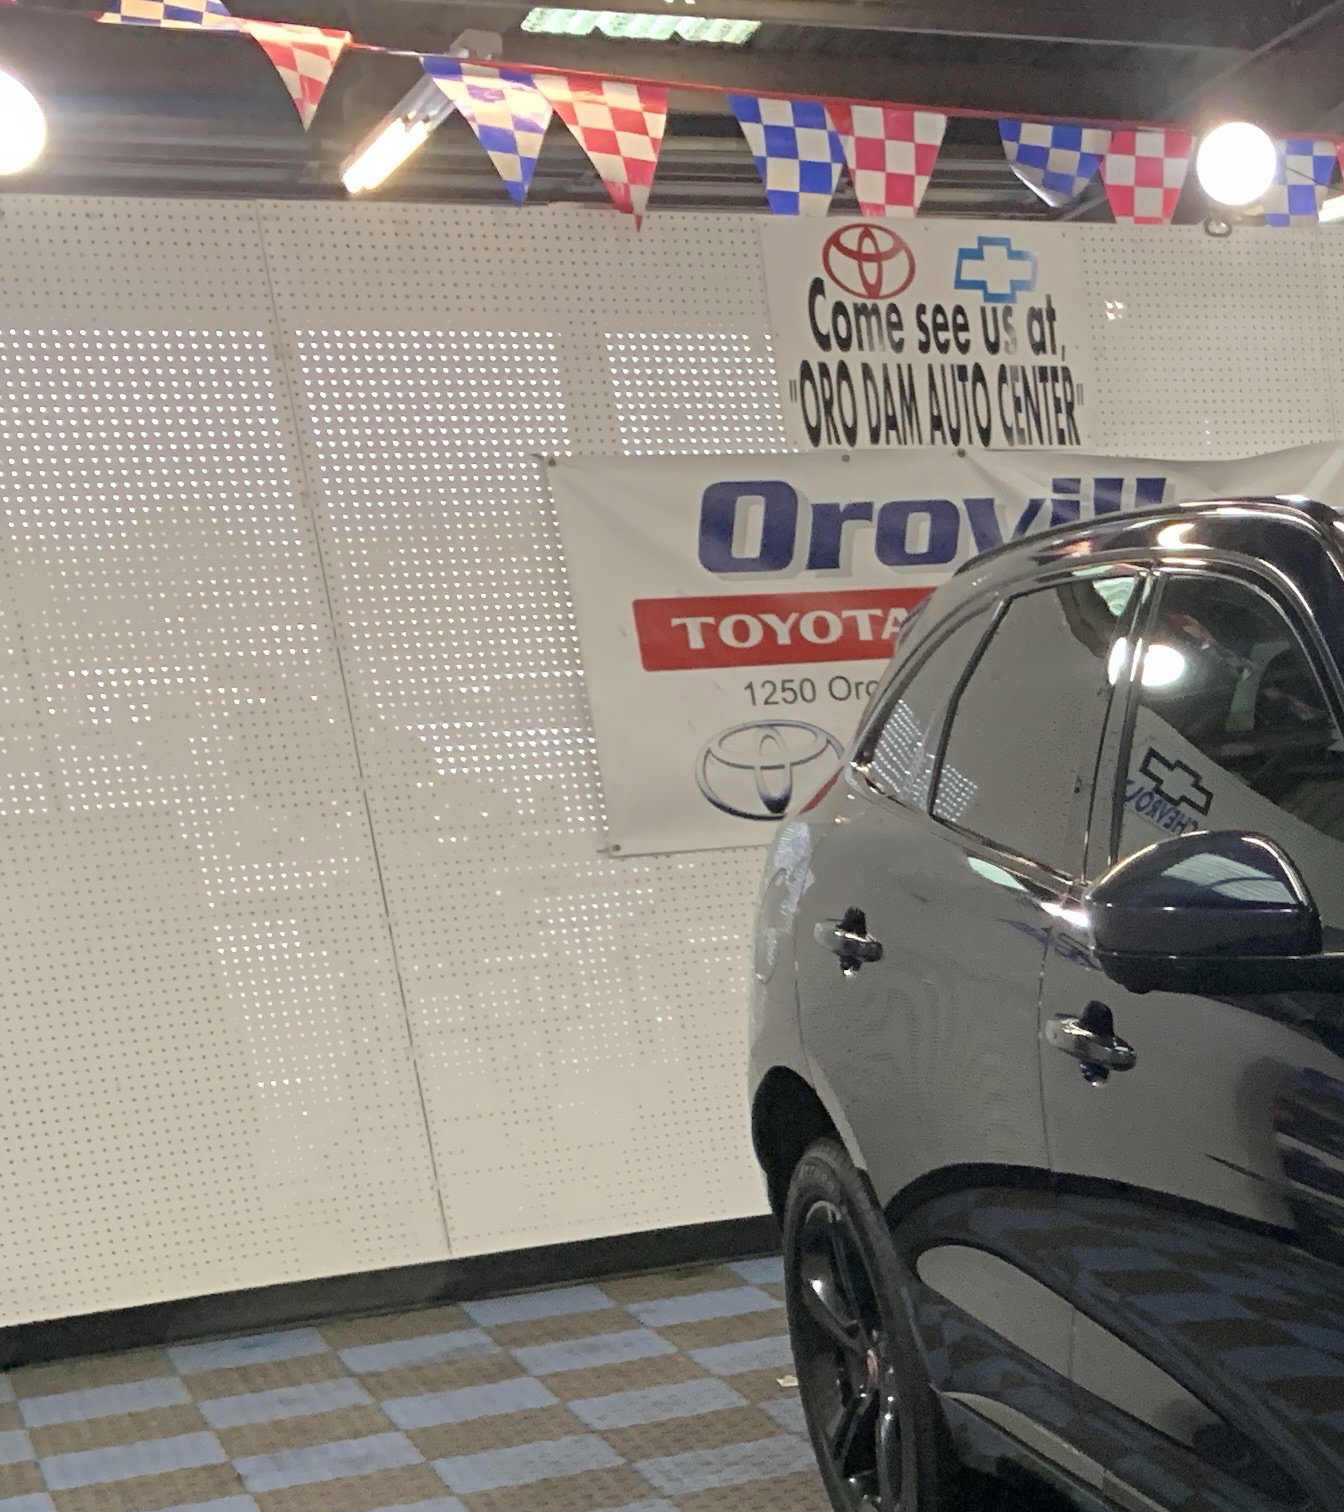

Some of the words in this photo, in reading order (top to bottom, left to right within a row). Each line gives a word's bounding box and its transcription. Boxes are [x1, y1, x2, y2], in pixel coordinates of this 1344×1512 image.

[808, 277, 904, 354] Come
[916, 302, 971, 355] see
[981, 305, 1018, 356] us
[861, 361, 922, 446] DAM
[926, 361, 991, 447] AUTO
[670, 607, 910, 650] TOYOTA
[743, 677, 817, 706] 1250
